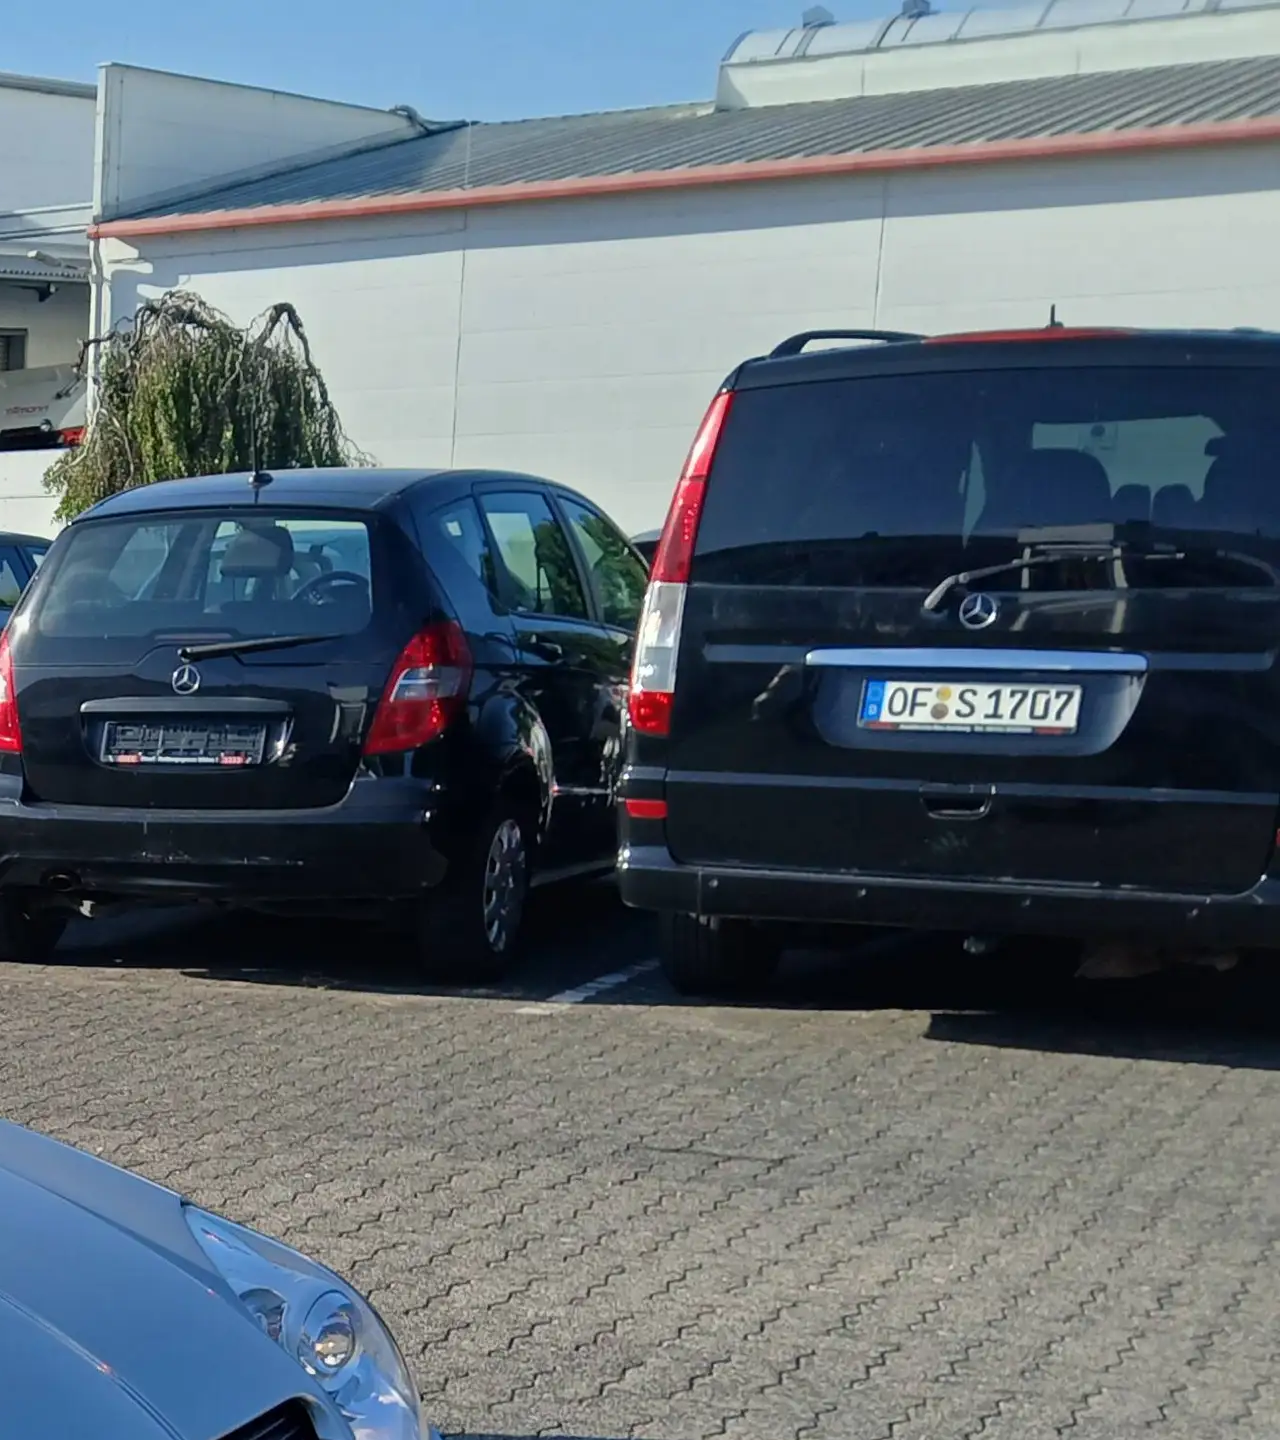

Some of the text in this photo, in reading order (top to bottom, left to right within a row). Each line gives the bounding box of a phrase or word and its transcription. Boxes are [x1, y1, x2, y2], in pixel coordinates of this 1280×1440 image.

[888, 687, 1074, 721] OF S 1707
